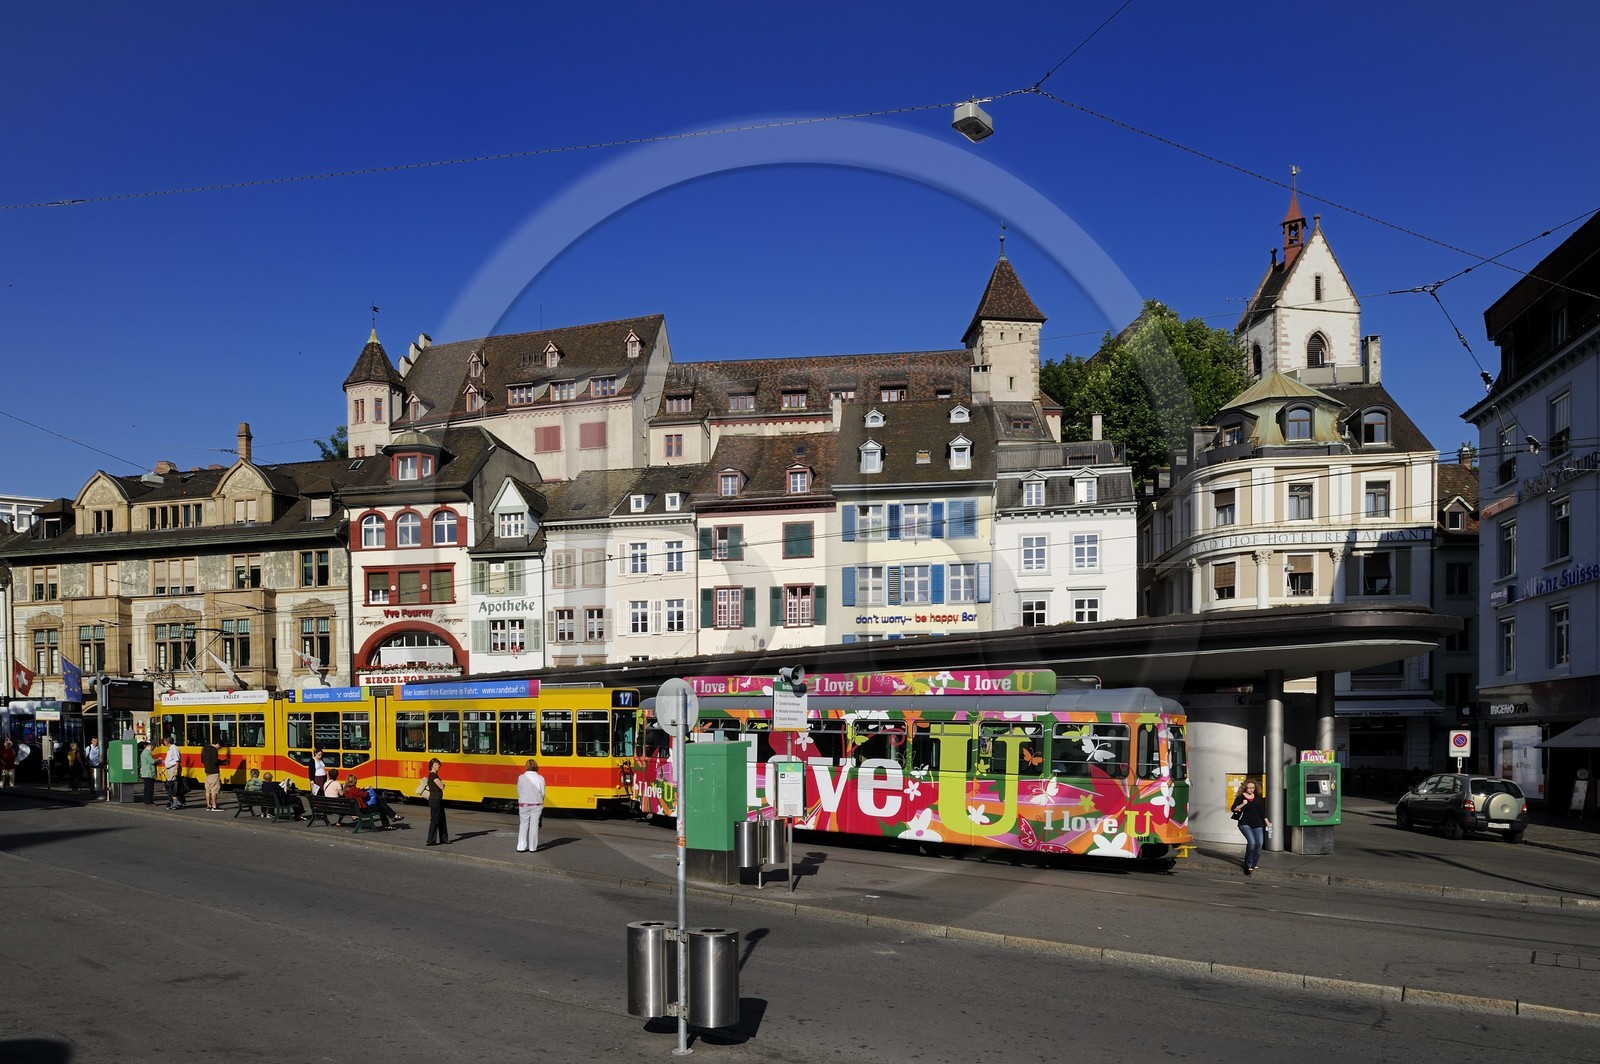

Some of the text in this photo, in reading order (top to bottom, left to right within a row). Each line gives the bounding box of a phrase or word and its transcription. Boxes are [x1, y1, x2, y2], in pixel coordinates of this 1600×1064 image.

[1189, 528, 1431, 554] STADTHOF HOTEL RESTAURANT
[1522, 562, 1600, 598] Allianz Suisse
[478, 600, 535, 615] Apotheke
[855, 614, 879, 624] don't
[915, 612, 927, 623] be
[930, 612, 959, 624] happy
[961, 612, 977, 622] Bar
[482, 685, 526, 694] www.randstad.ch
[701, 679, 726, 695] love
[728, 677, 740, 695] U
[814, 674, 872, 693] I love U
[963, 672, 1034, 692] I love U
[619, 692, 631, 705] 17
[1307, 753, 1325, 762] love
[930, 724, 1032, 838] U
[644, 782, 663, 800] love
[664, 782, 675, 802] U
[1043, 809, 1153, 839] I love U
